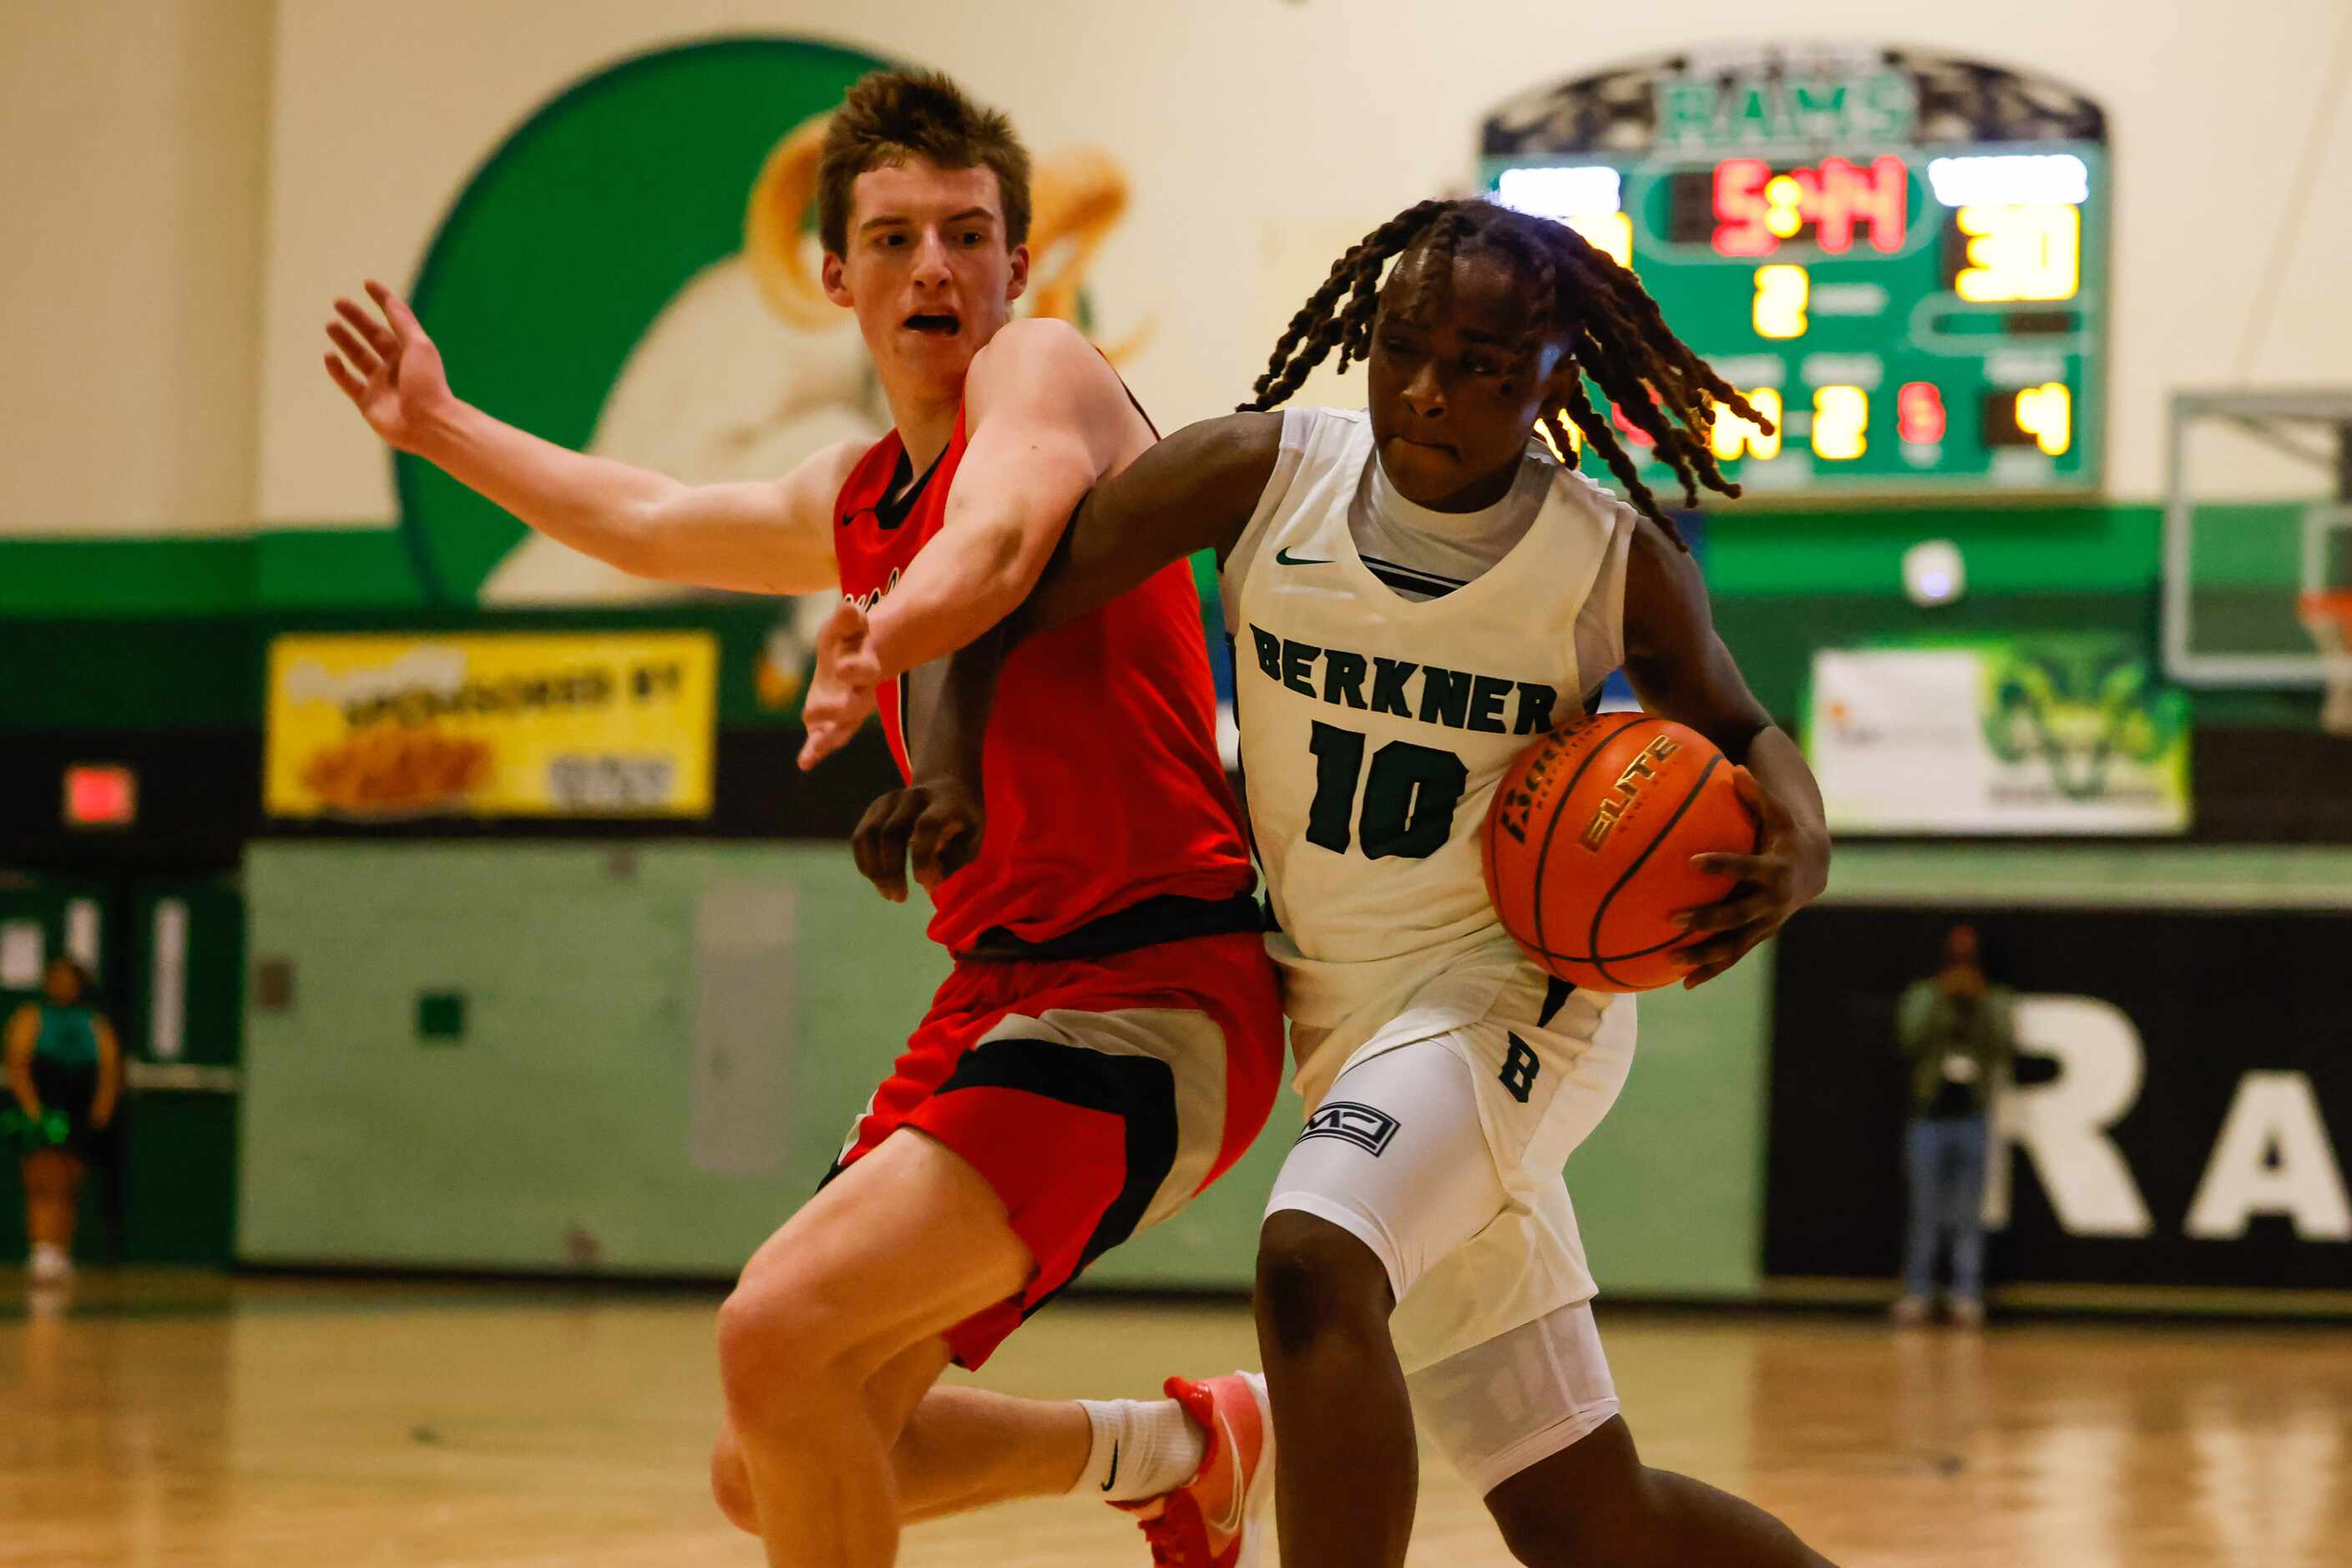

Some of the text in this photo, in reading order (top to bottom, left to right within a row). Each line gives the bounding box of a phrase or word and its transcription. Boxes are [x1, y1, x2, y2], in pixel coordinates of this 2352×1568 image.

[1662, 75, 1915, 148] RAMS
[1712, 156, 1908, 257] 5:44
[1955, 203, 2081, 302] 30
[1753, 265, 1809, 338] 2
[1812, 385, 1869, 459] 2
[1249, 623, 1557, 736] BERKNER
[1306, 720, 1469, 861] 10
[1579, 733, 1681, 853] ELITE
[1498, 1029, 1540, 1104] B
